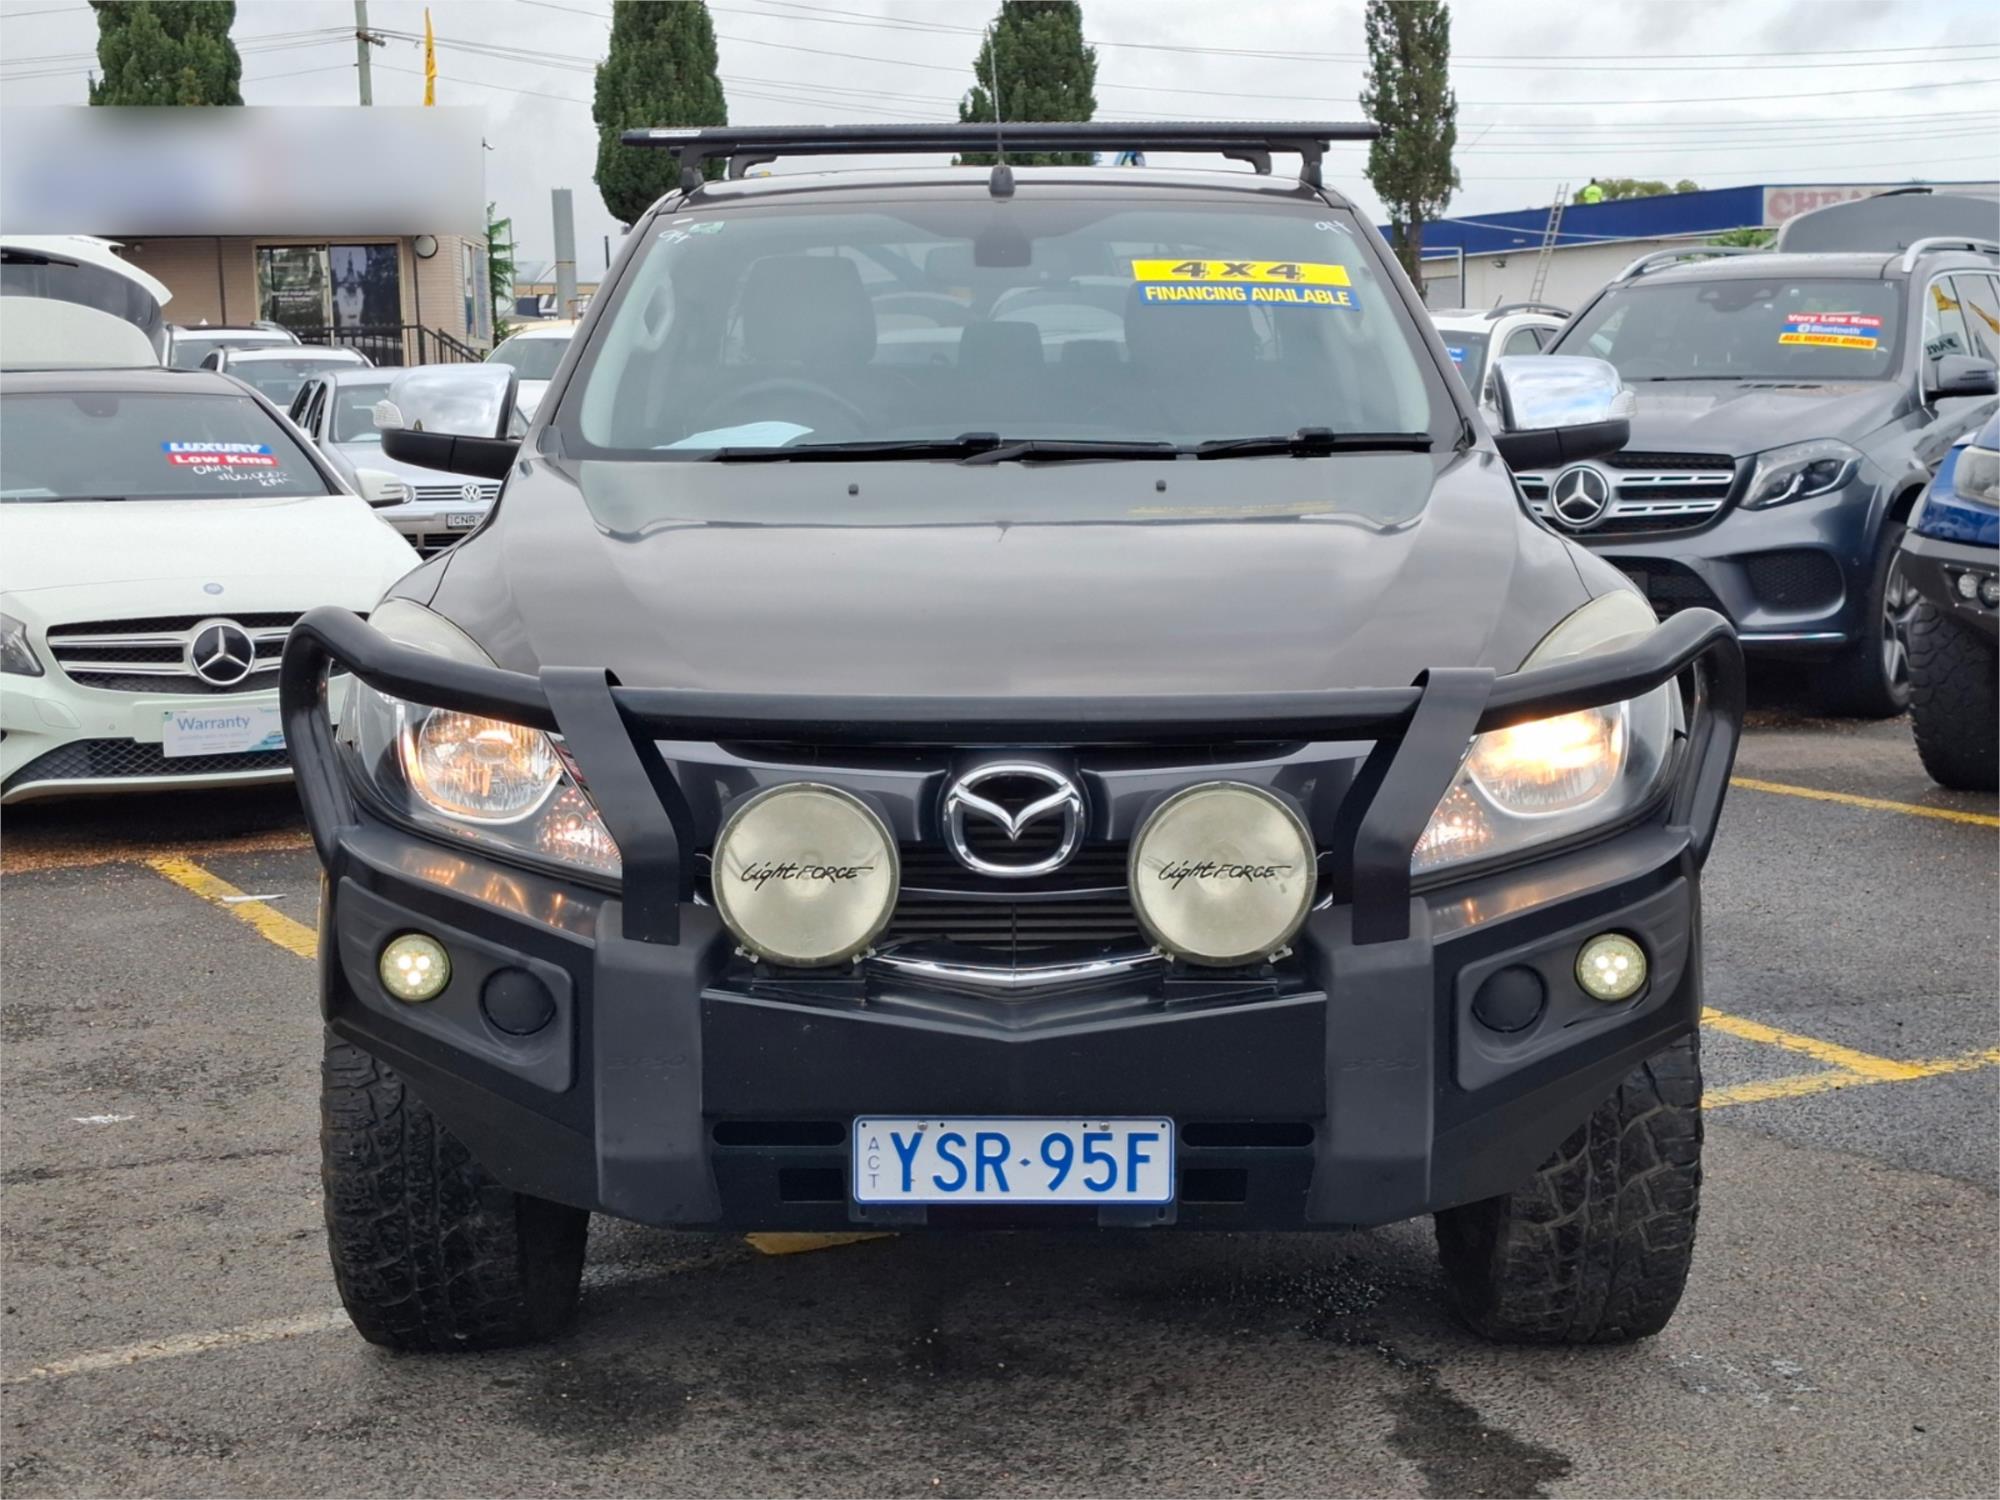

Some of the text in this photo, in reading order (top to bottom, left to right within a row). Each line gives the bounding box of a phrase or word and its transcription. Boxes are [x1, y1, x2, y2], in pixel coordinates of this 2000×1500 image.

[1145, 285, 1352, 306] FINANCING AVAILABLE
[1788, 314, 1880, 326] Very Low Kms
[1811, 325, 1862, 334] Bluetooth
[1803, 335, 1838, 344] WHEEL
[1841, 337, 1875, 347] DRIVE
[169, 442, 262, 453] LUXURY
[174, 455, 274, 465] Low Kms
[177, 716, 250, 731] Warranty
[867, 1136, 881, 1189] ACT
